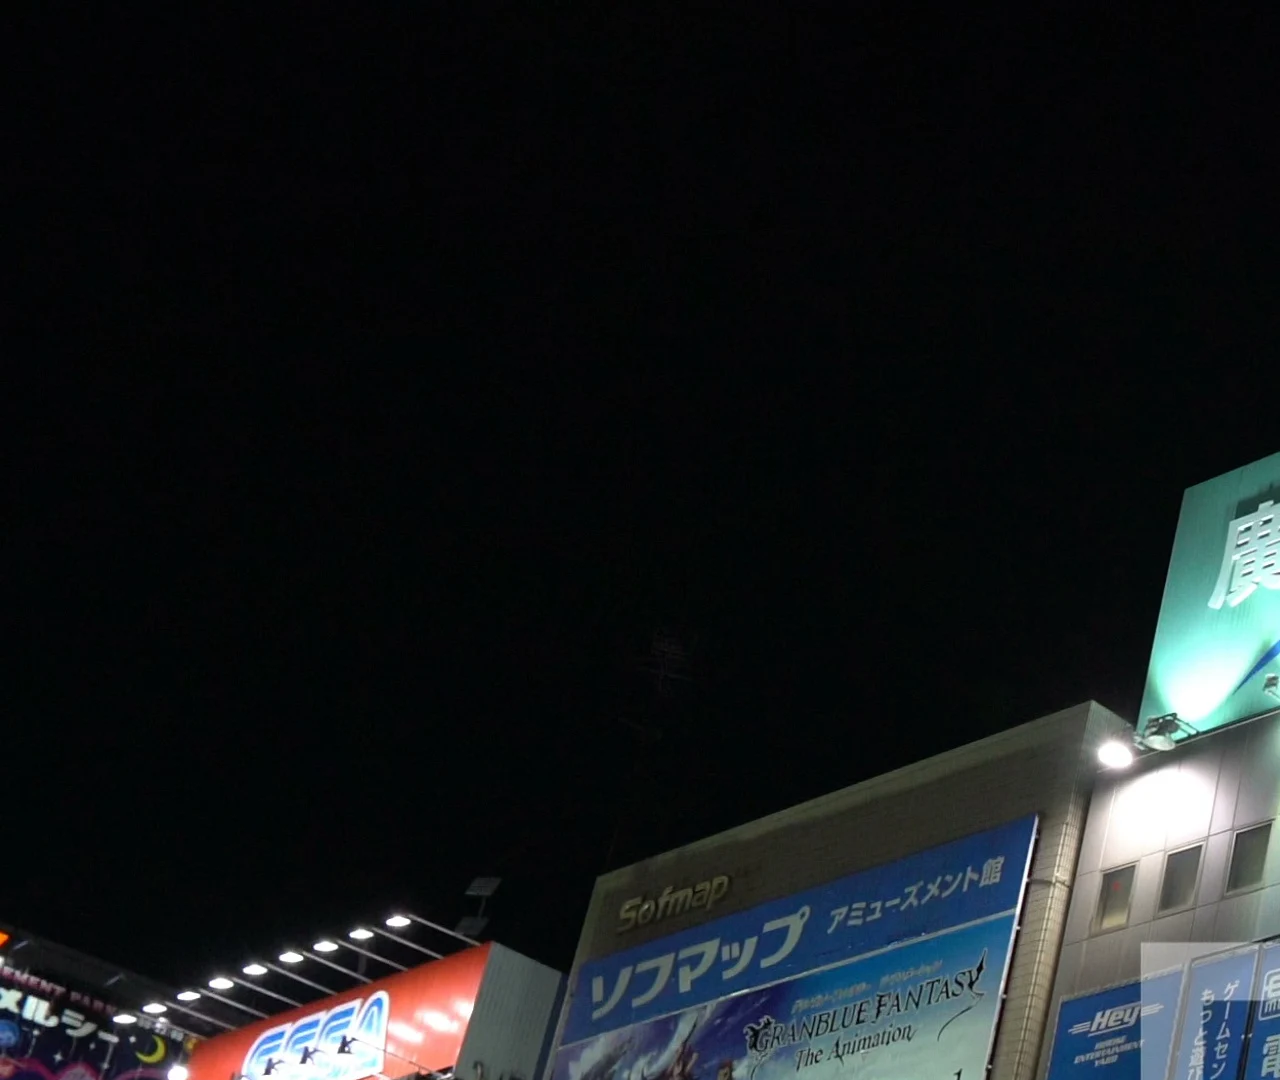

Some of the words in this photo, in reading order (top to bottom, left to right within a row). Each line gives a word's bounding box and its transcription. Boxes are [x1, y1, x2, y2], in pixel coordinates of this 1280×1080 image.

[616, 874, 731, 934] Sofmap
[591, 904, 812, 1020] ソフマップ
[826, 855, 1006, 934] アミューズメント館
[745, 1003, 868, 1060] GRANBLUE
[873, 950, 987, 1026] FANTASY
[1089, 1002, 1141, 1036] Hey
[796, 1046, 824, 1073] The
[827, 1022, 918, 1066] Animation
